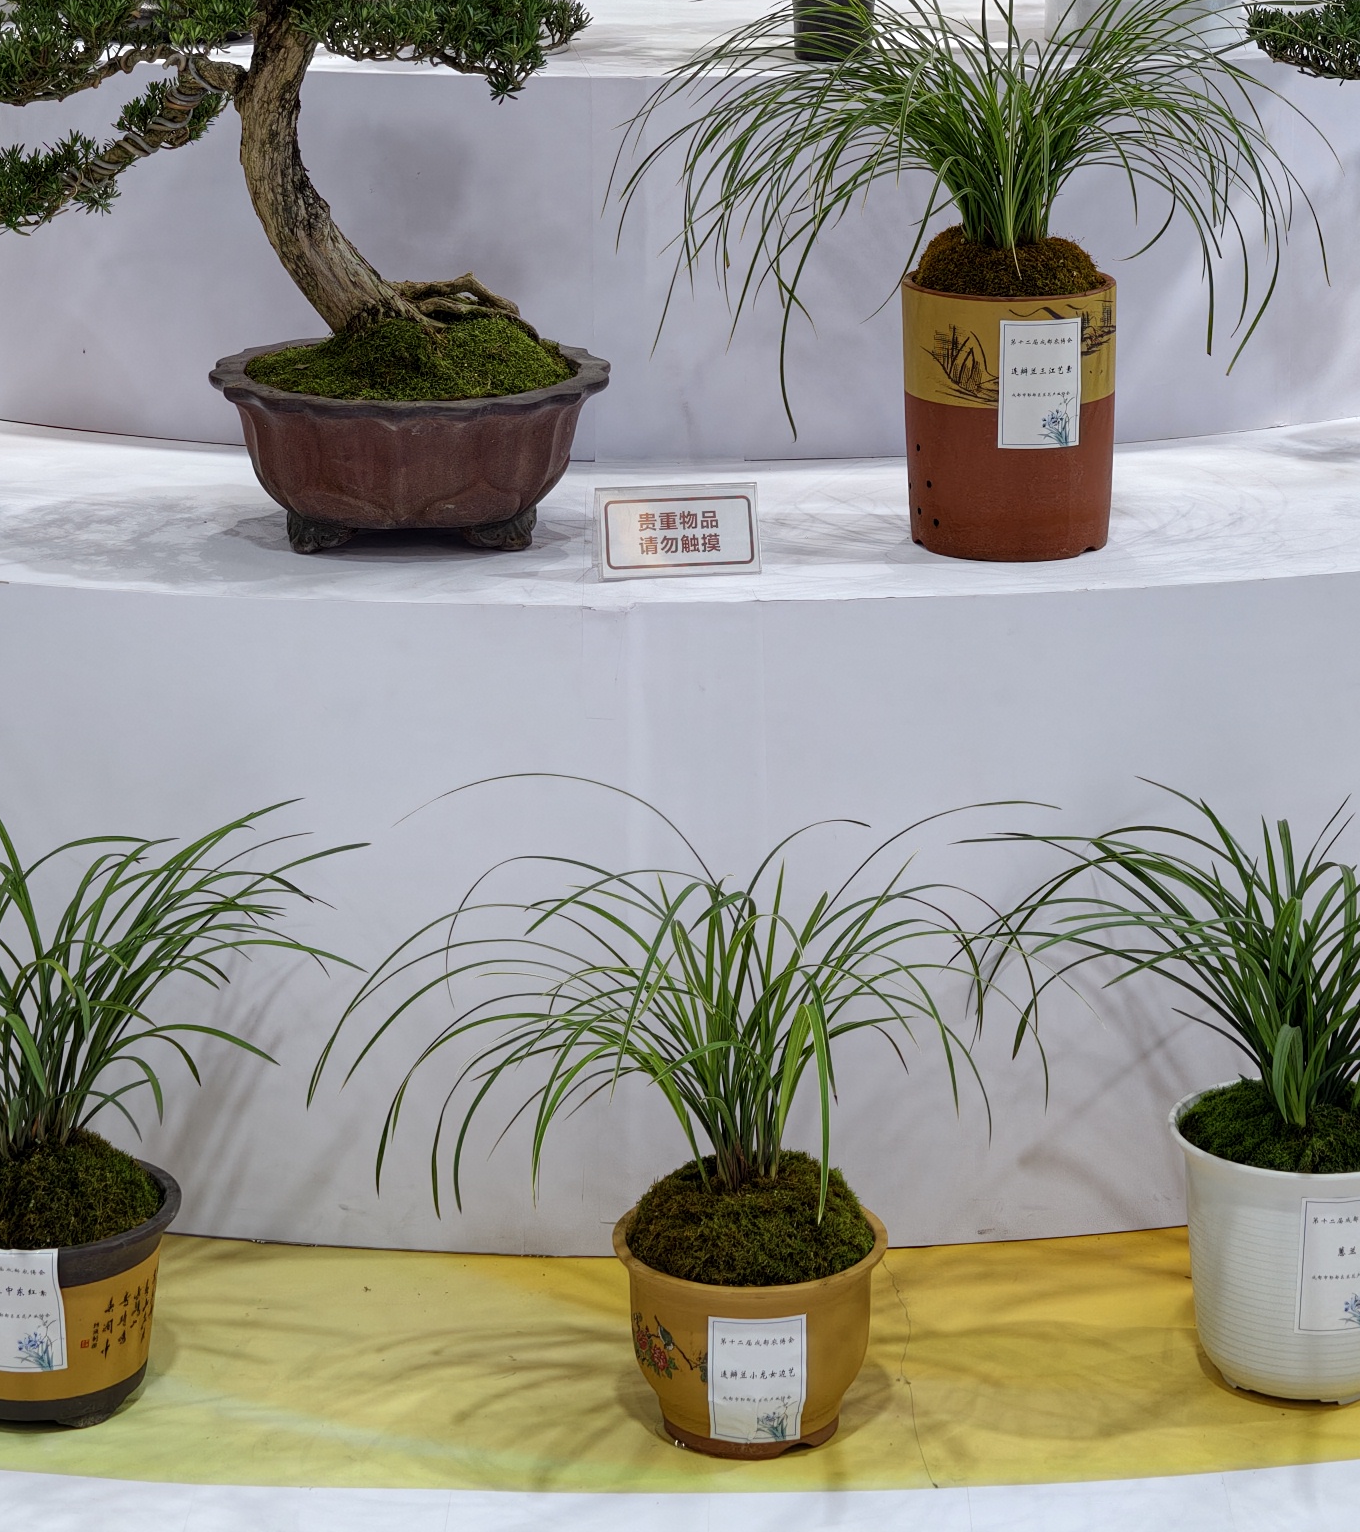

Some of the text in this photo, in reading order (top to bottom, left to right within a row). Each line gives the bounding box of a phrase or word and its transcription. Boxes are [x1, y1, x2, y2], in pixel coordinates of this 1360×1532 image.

[638, 510, 719, 532] 贵重物品
[639, 533, 722, 555] 请勿触摸
